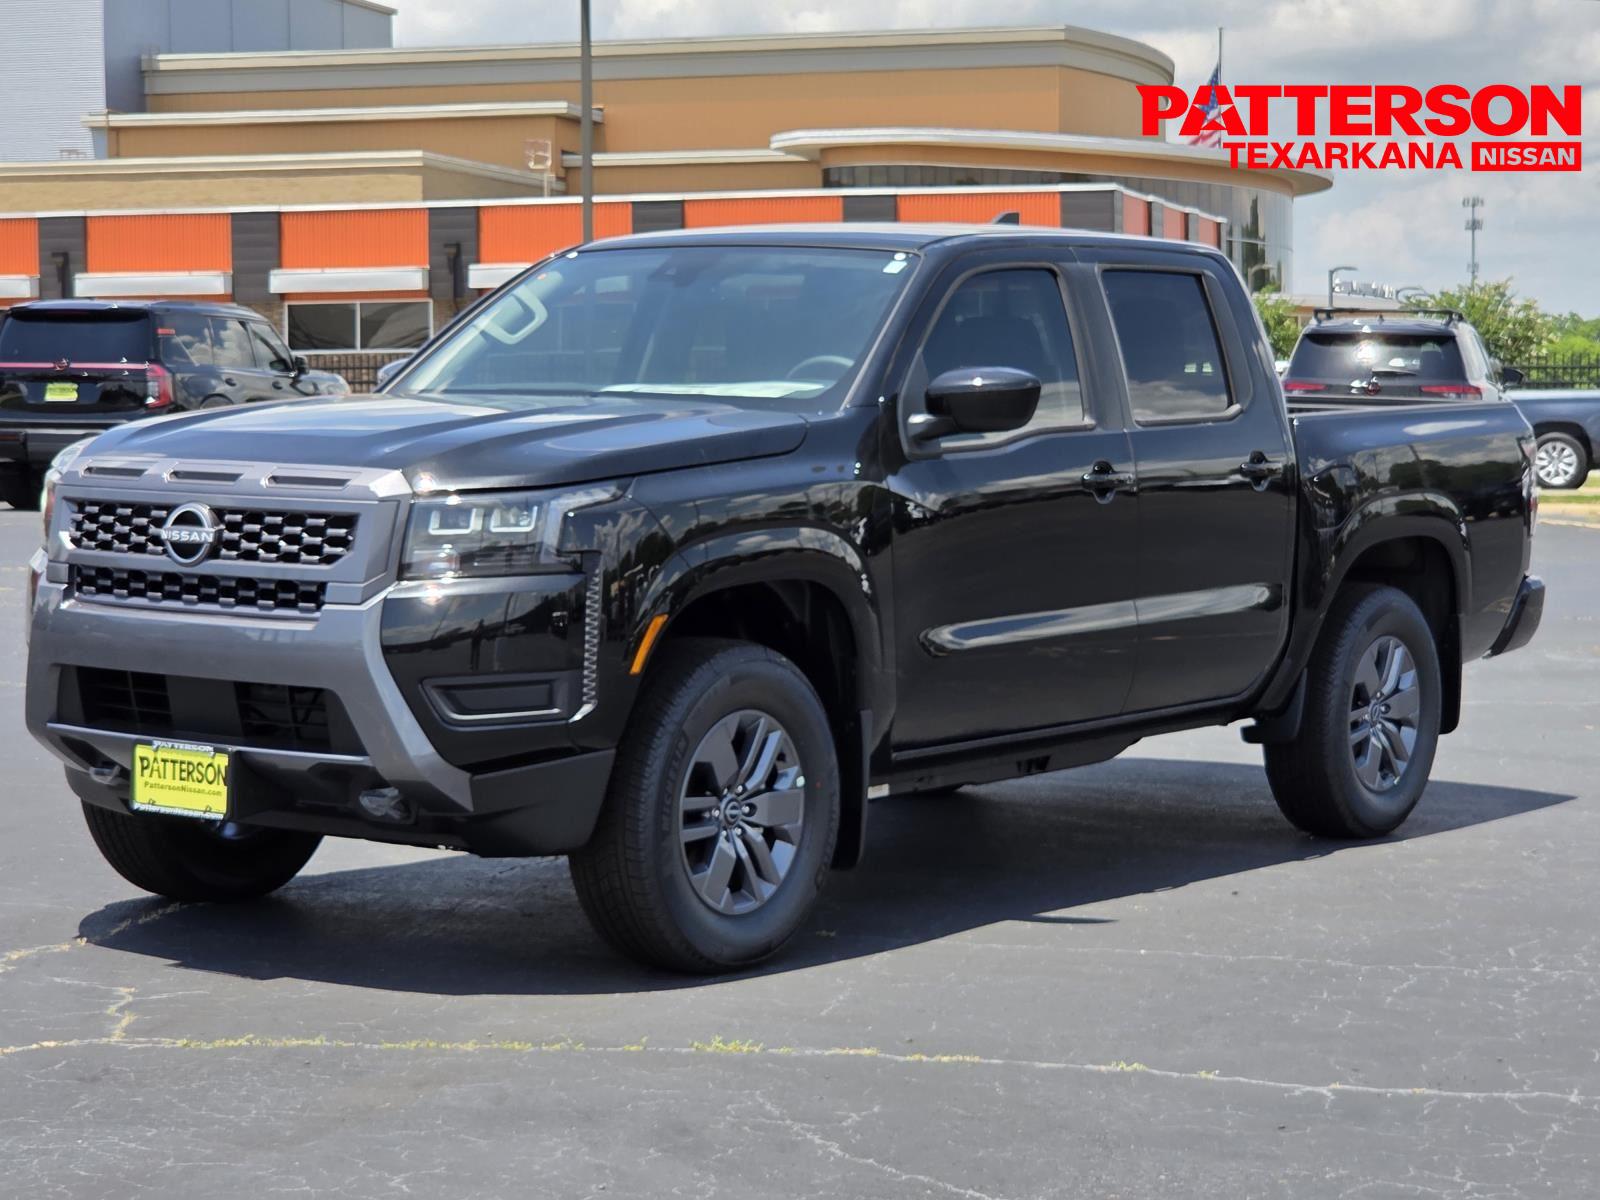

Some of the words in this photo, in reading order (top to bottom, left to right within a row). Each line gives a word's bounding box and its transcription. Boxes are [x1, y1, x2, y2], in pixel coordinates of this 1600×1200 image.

[161, 529, 213, 543] NISSAN
[139, 756, 228, 786] PATTERSON
[144, 781, 222, 796] PattersonNissan.com
